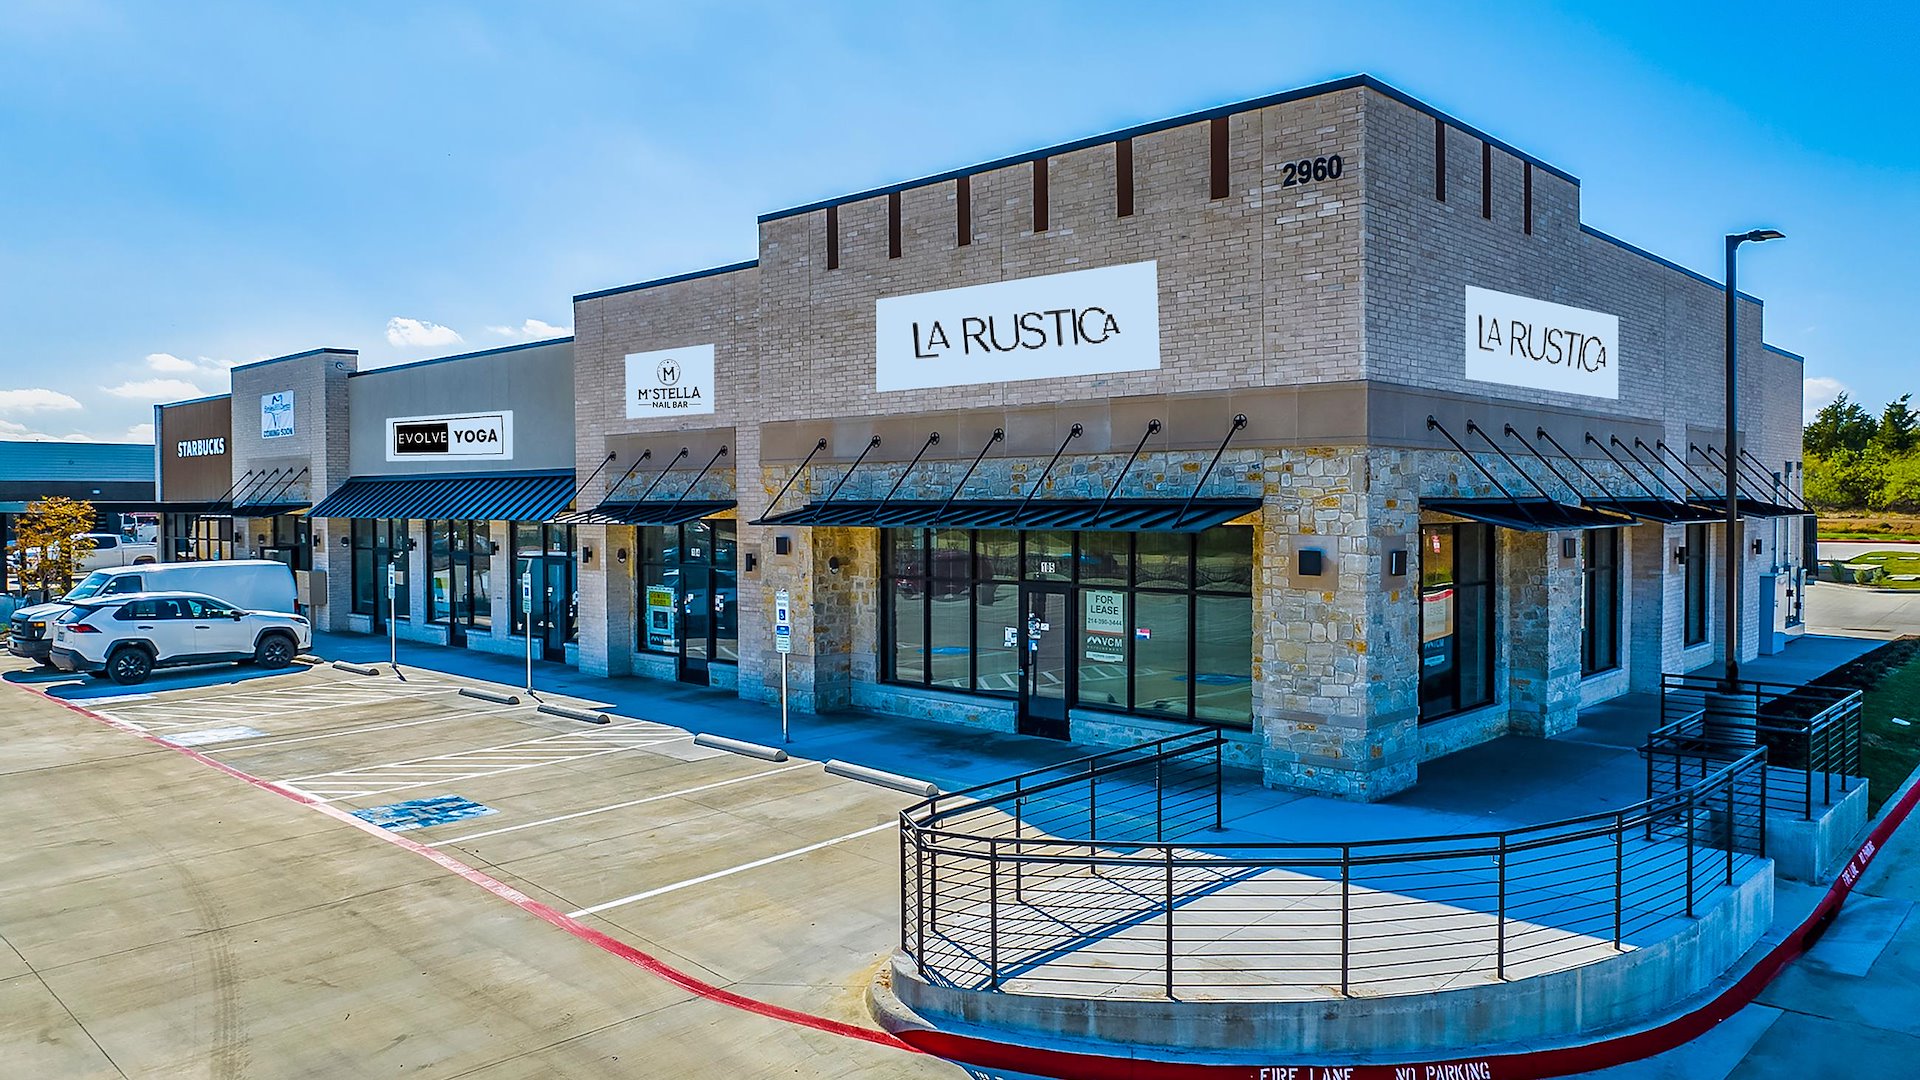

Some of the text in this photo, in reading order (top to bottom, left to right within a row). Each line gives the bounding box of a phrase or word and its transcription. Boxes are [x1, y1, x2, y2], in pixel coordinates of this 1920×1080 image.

[1282, 154, 1343, 187] 2960
[912, 306, 1120, 359] LA RUSTICA
[1478, 314, 1606, 373] LA RUSTICA
[652, 401, 688, 409] NAIL BAR
[398, 428, 498, 444] EVOLVE YOGA
[177, 438, 225, 457] STARBUCKS
[1095, 594, 1113, 605] FOR
[1090, 604, 1119, 615] LEASE
[1395, 1067, 1416, 1080] NO
[1425, 1061, 1491, 1080] PARKING
